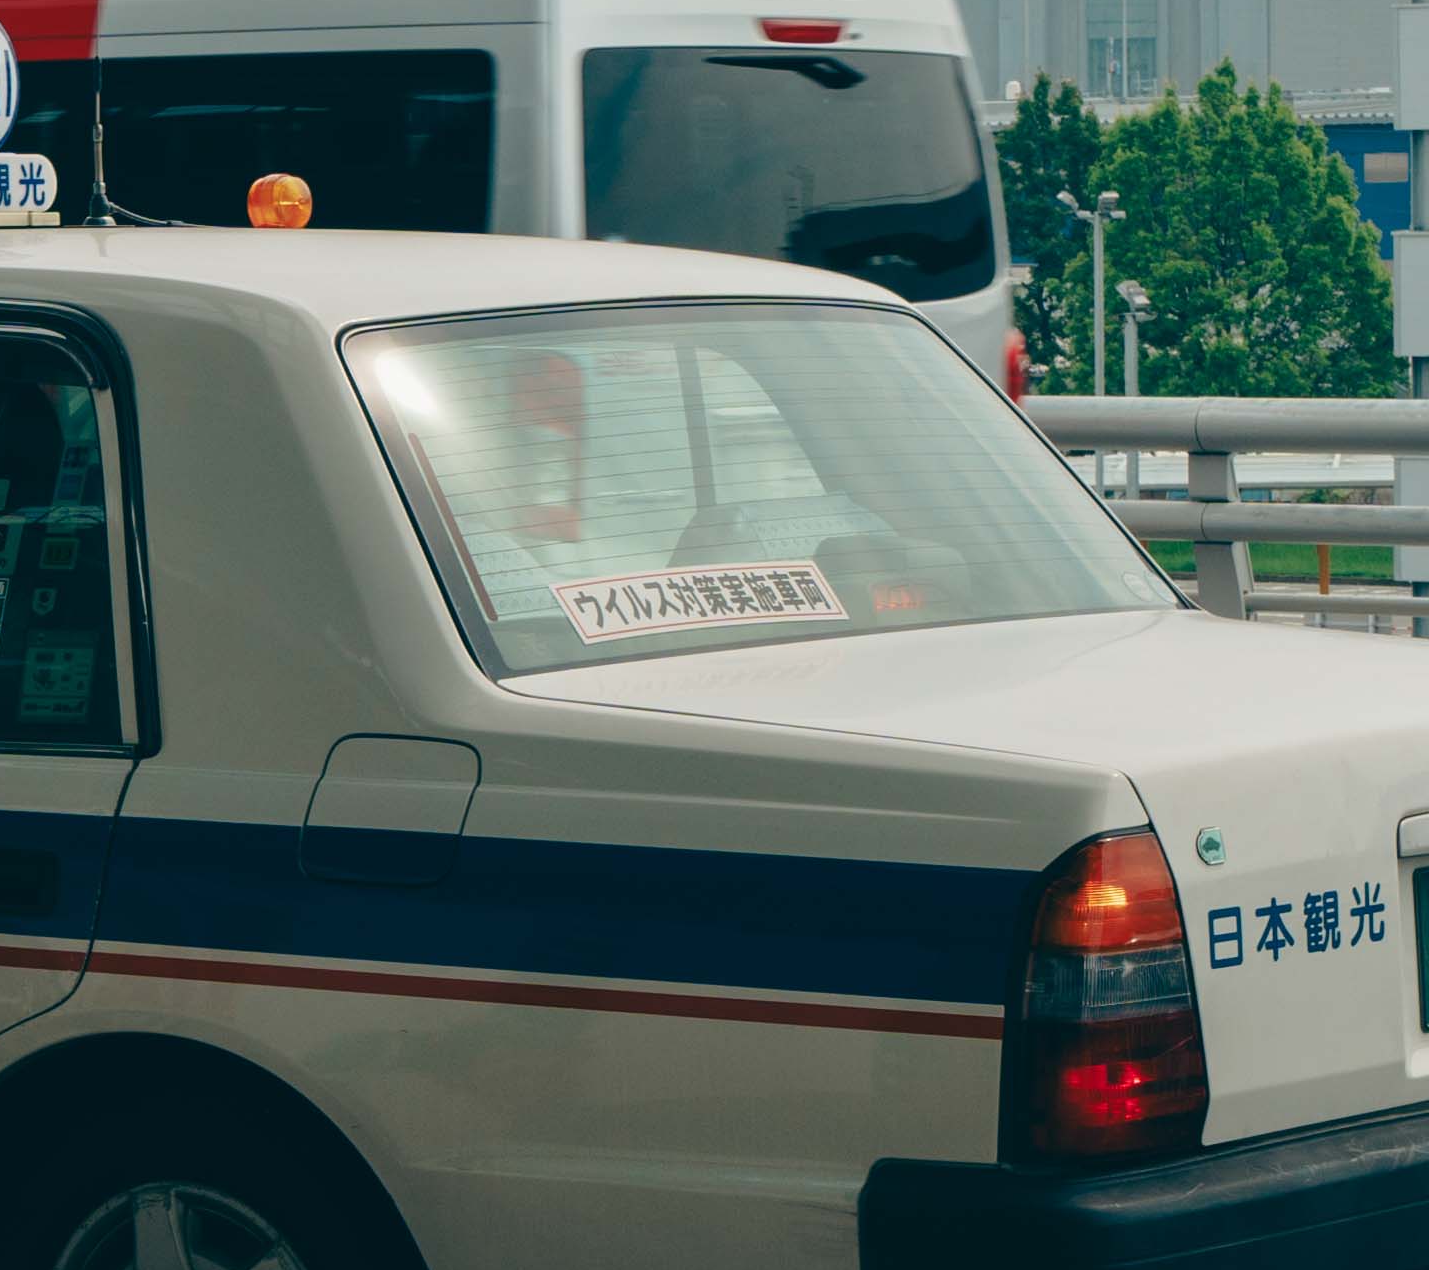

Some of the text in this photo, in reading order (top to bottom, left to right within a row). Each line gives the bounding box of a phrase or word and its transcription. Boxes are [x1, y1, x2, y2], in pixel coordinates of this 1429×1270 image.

[573, 569, 832, 629] ウイルス対策実施車両
[1207, 879, 1386, 970] 日本観光
